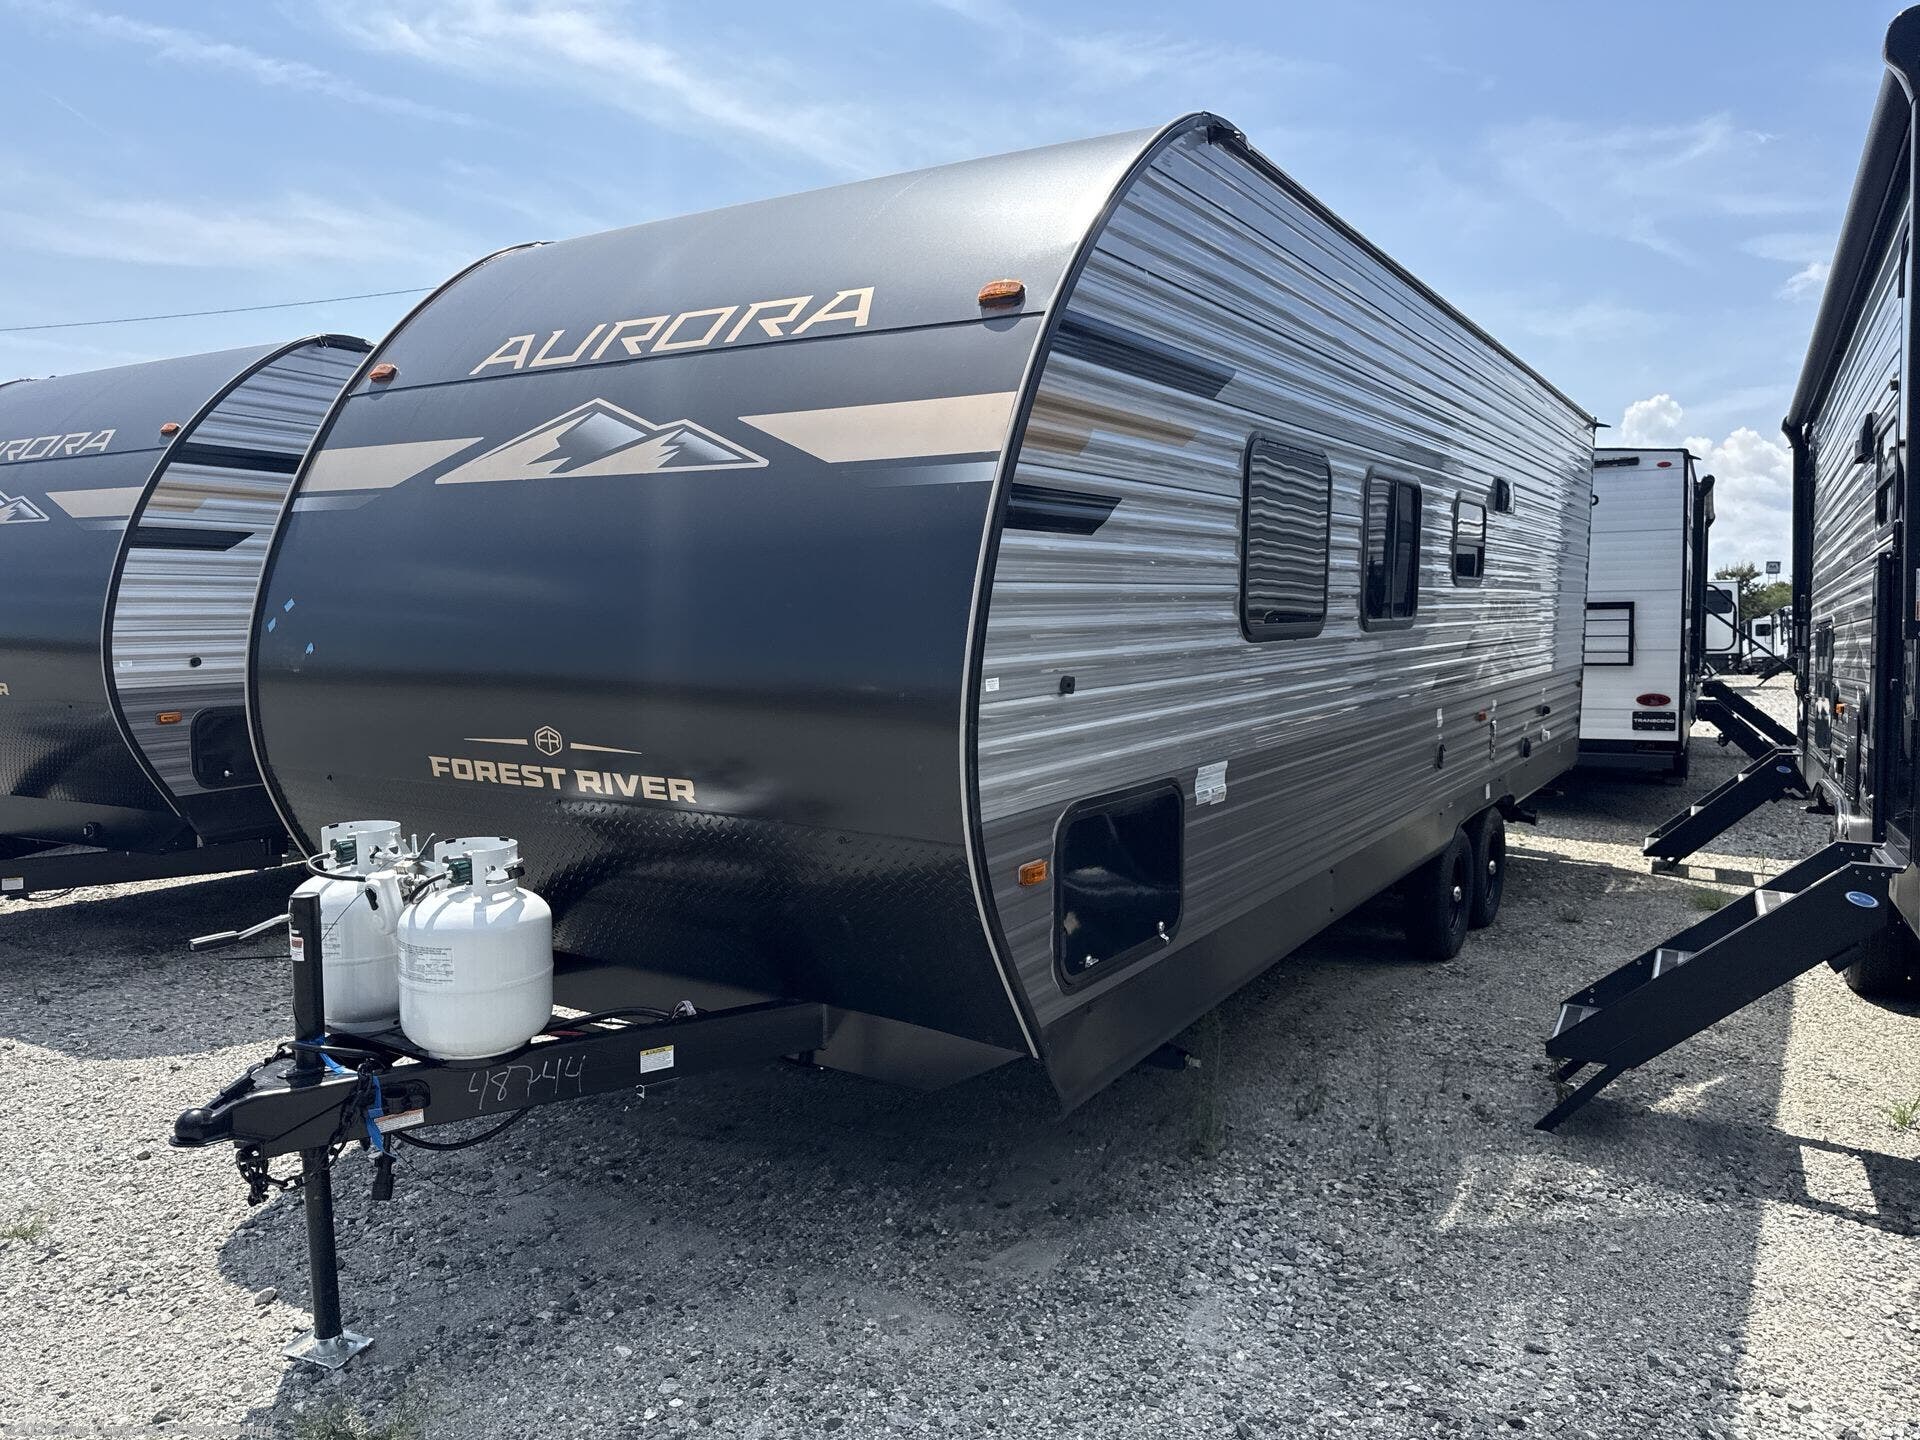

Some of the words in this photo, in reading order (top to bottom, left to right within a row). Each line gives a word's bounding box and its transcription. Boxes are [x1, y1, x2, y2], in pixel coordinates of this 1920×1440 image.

[469, 286, 875, 376] AURORA
[0, 429, 117, 461] RORA
[428, 755, 566, 790] FOREST
[574, 769, 697, 804] RIVER
[468, 1055, 586, 1110] 48744
